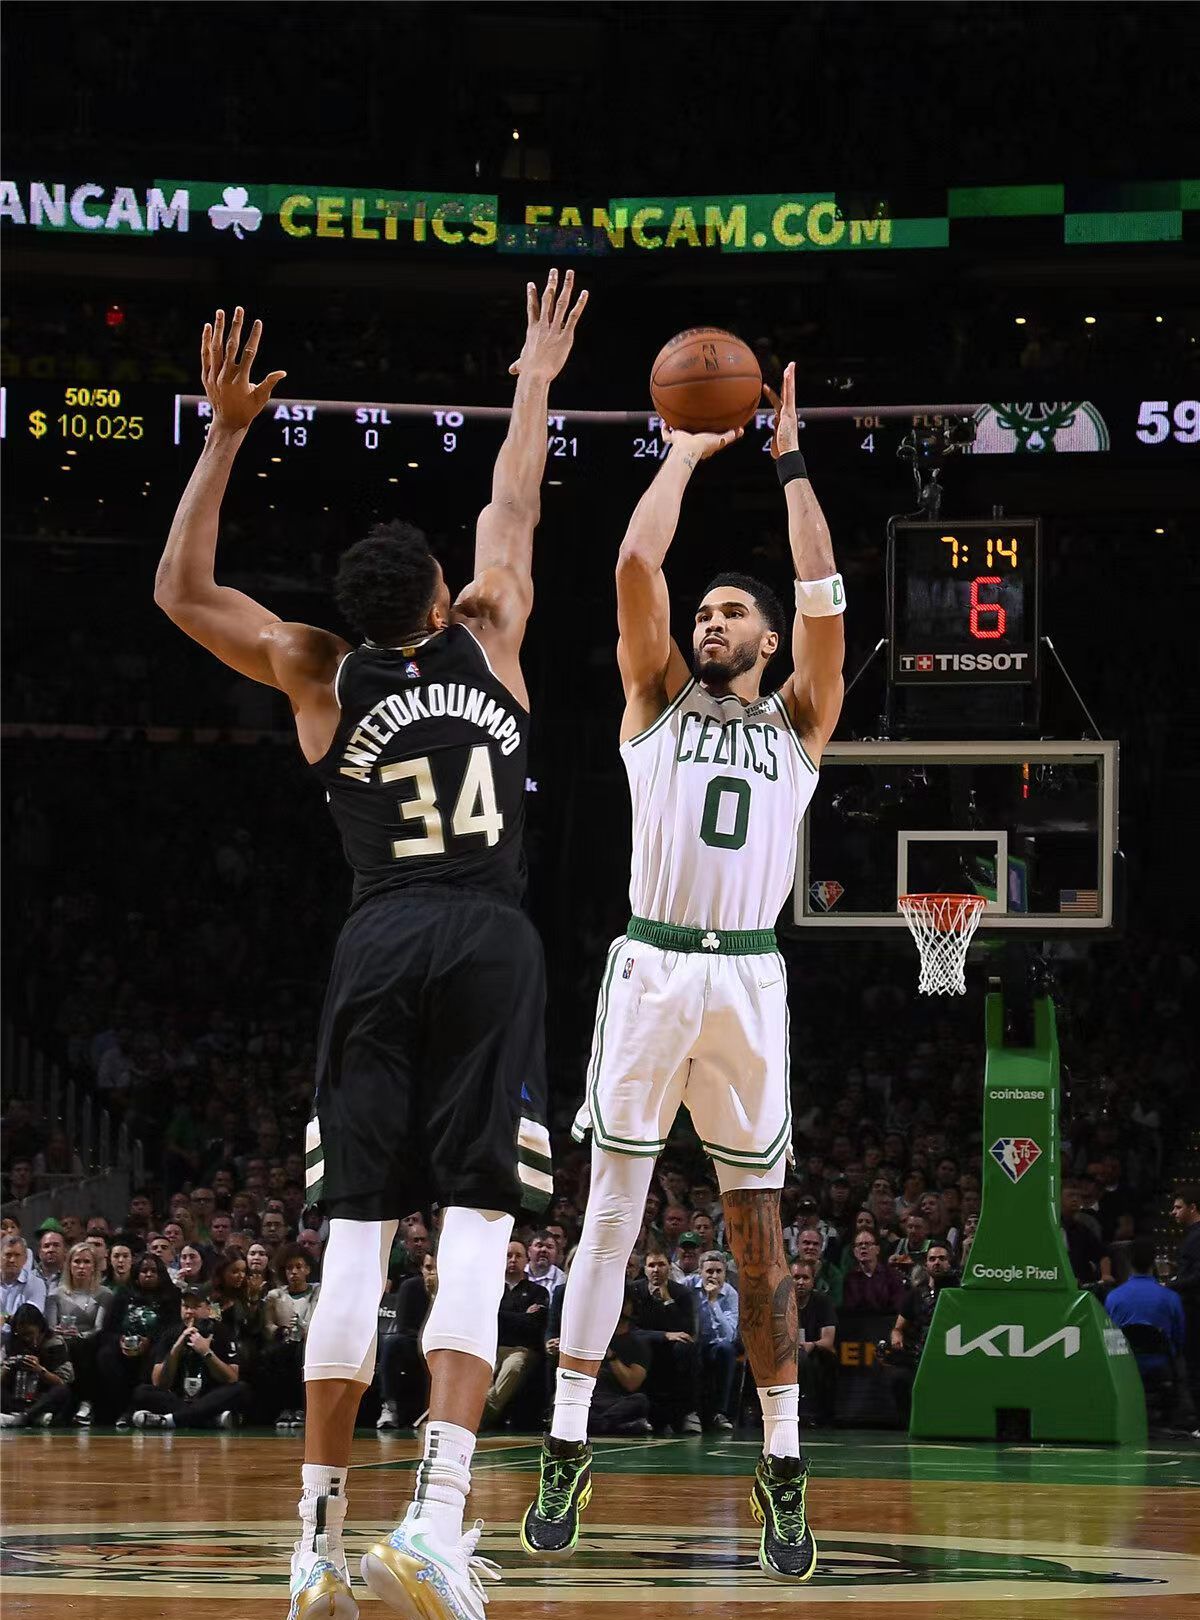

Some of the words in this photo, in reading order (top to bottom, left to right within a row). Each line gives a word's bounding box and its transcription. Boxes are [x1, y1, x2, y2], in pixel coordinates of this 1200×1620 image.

[65, 388, 121, 408] 50/50
[57, 413, 144, 441] 10,025
[273, 404, 316, 421] AST
[355, 408, 391, 425] STL
[433, 411, 465, 427] TO
[854, 415, 884, 428] TOL
[1135, 400, 1200, 444] 59
[281, 426, 307, 447] 13
[365, 430, 379, 449] 0
[443, 432, 457, 453] 9
[860, 434, 875, 453] 4
[940, 536, 1018, 569] 7:14
[969, 575, 1007, 639] 6
[936, 653, 1028, 671] TISSOT
[339, 683, 521, 784] ANTETOKOUNMPO
[378, 744, 504, 859] 34
[699, 775, 752, 851] 0
[989, 1088, 1046, 1101] coinbase
[972, 1263, 1024, 1283] Google
[1026, 1265, 1059, 1281] Pixel
